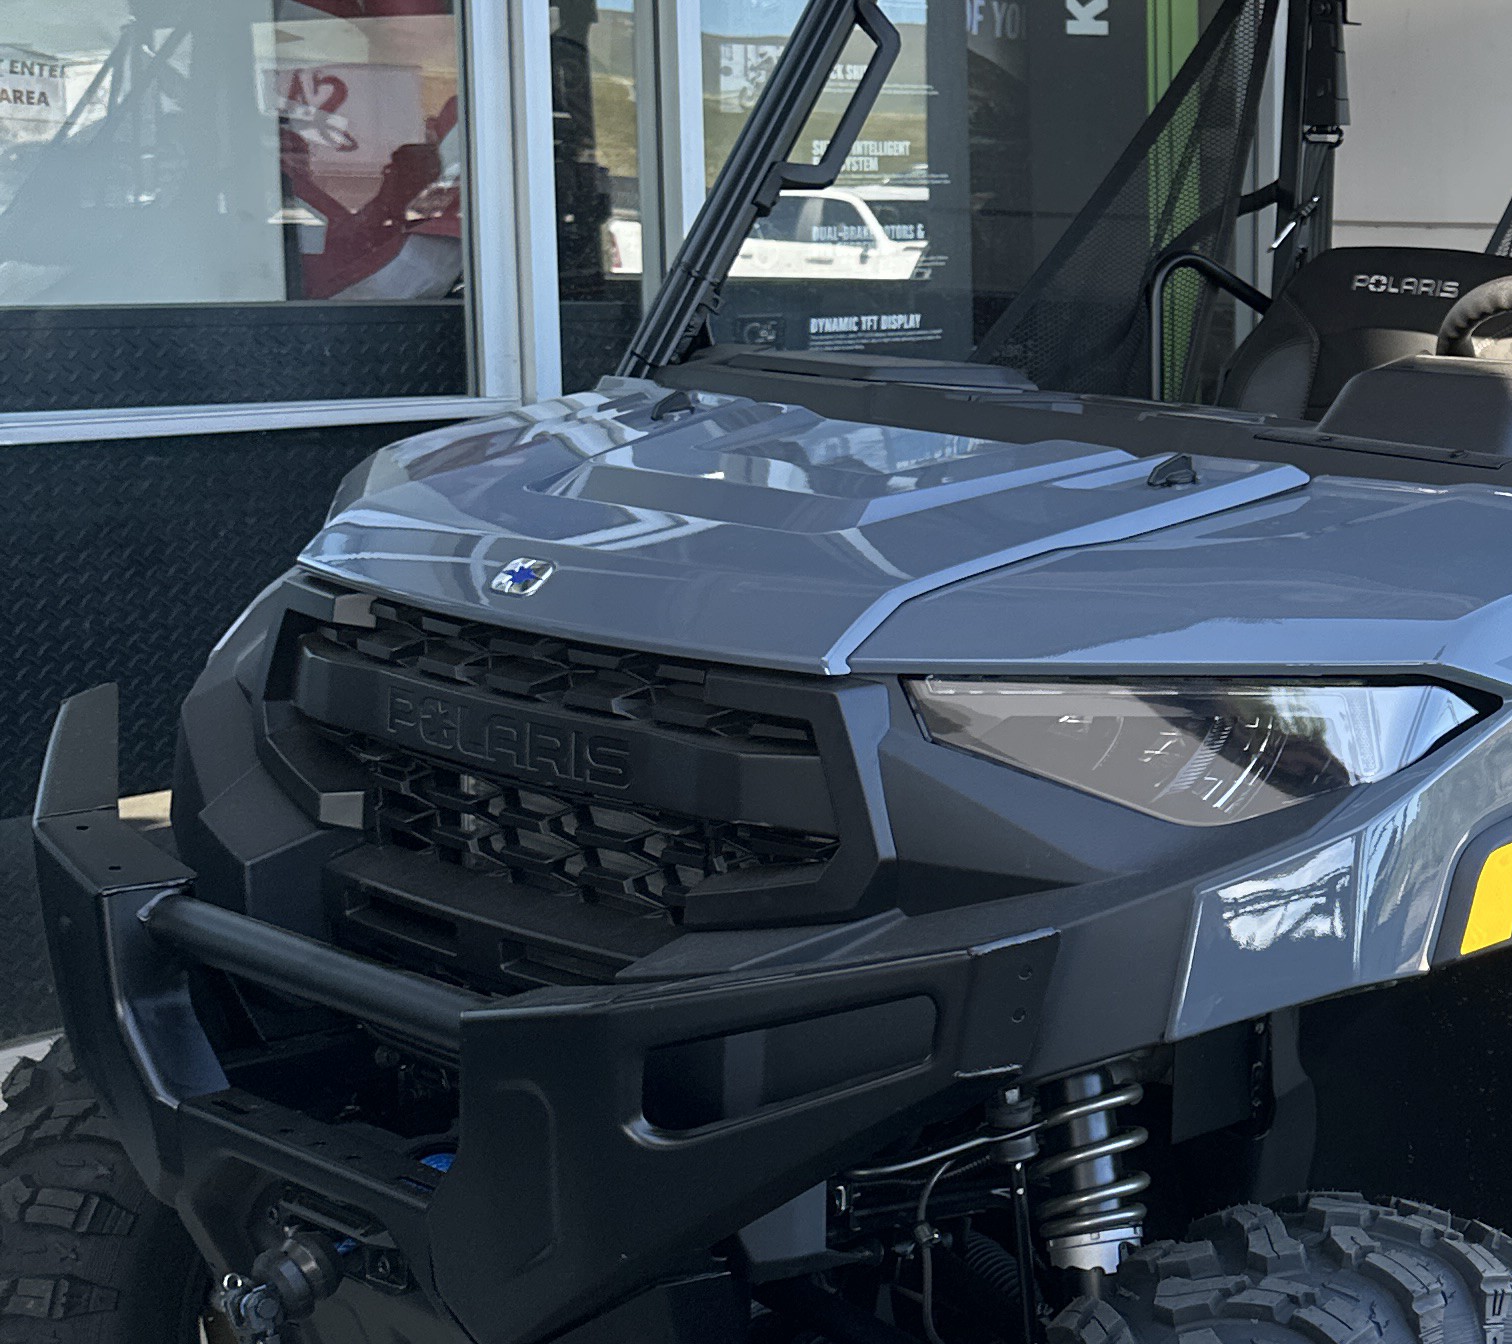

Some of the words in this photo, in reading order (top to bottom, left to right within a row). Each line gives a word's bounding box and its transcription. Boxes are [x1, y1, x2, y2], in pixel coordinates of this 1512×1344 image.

[993, 0, 1027, 39] YO
[1350, 274, 1460, 298] POLARIS
[809, 316, 859, 334] DYNAMIC
[861, 315, 879, 331] TFT
[880, 313, 921, 331] DISPLAY
[387, 685, 632, 790] POLARIS
